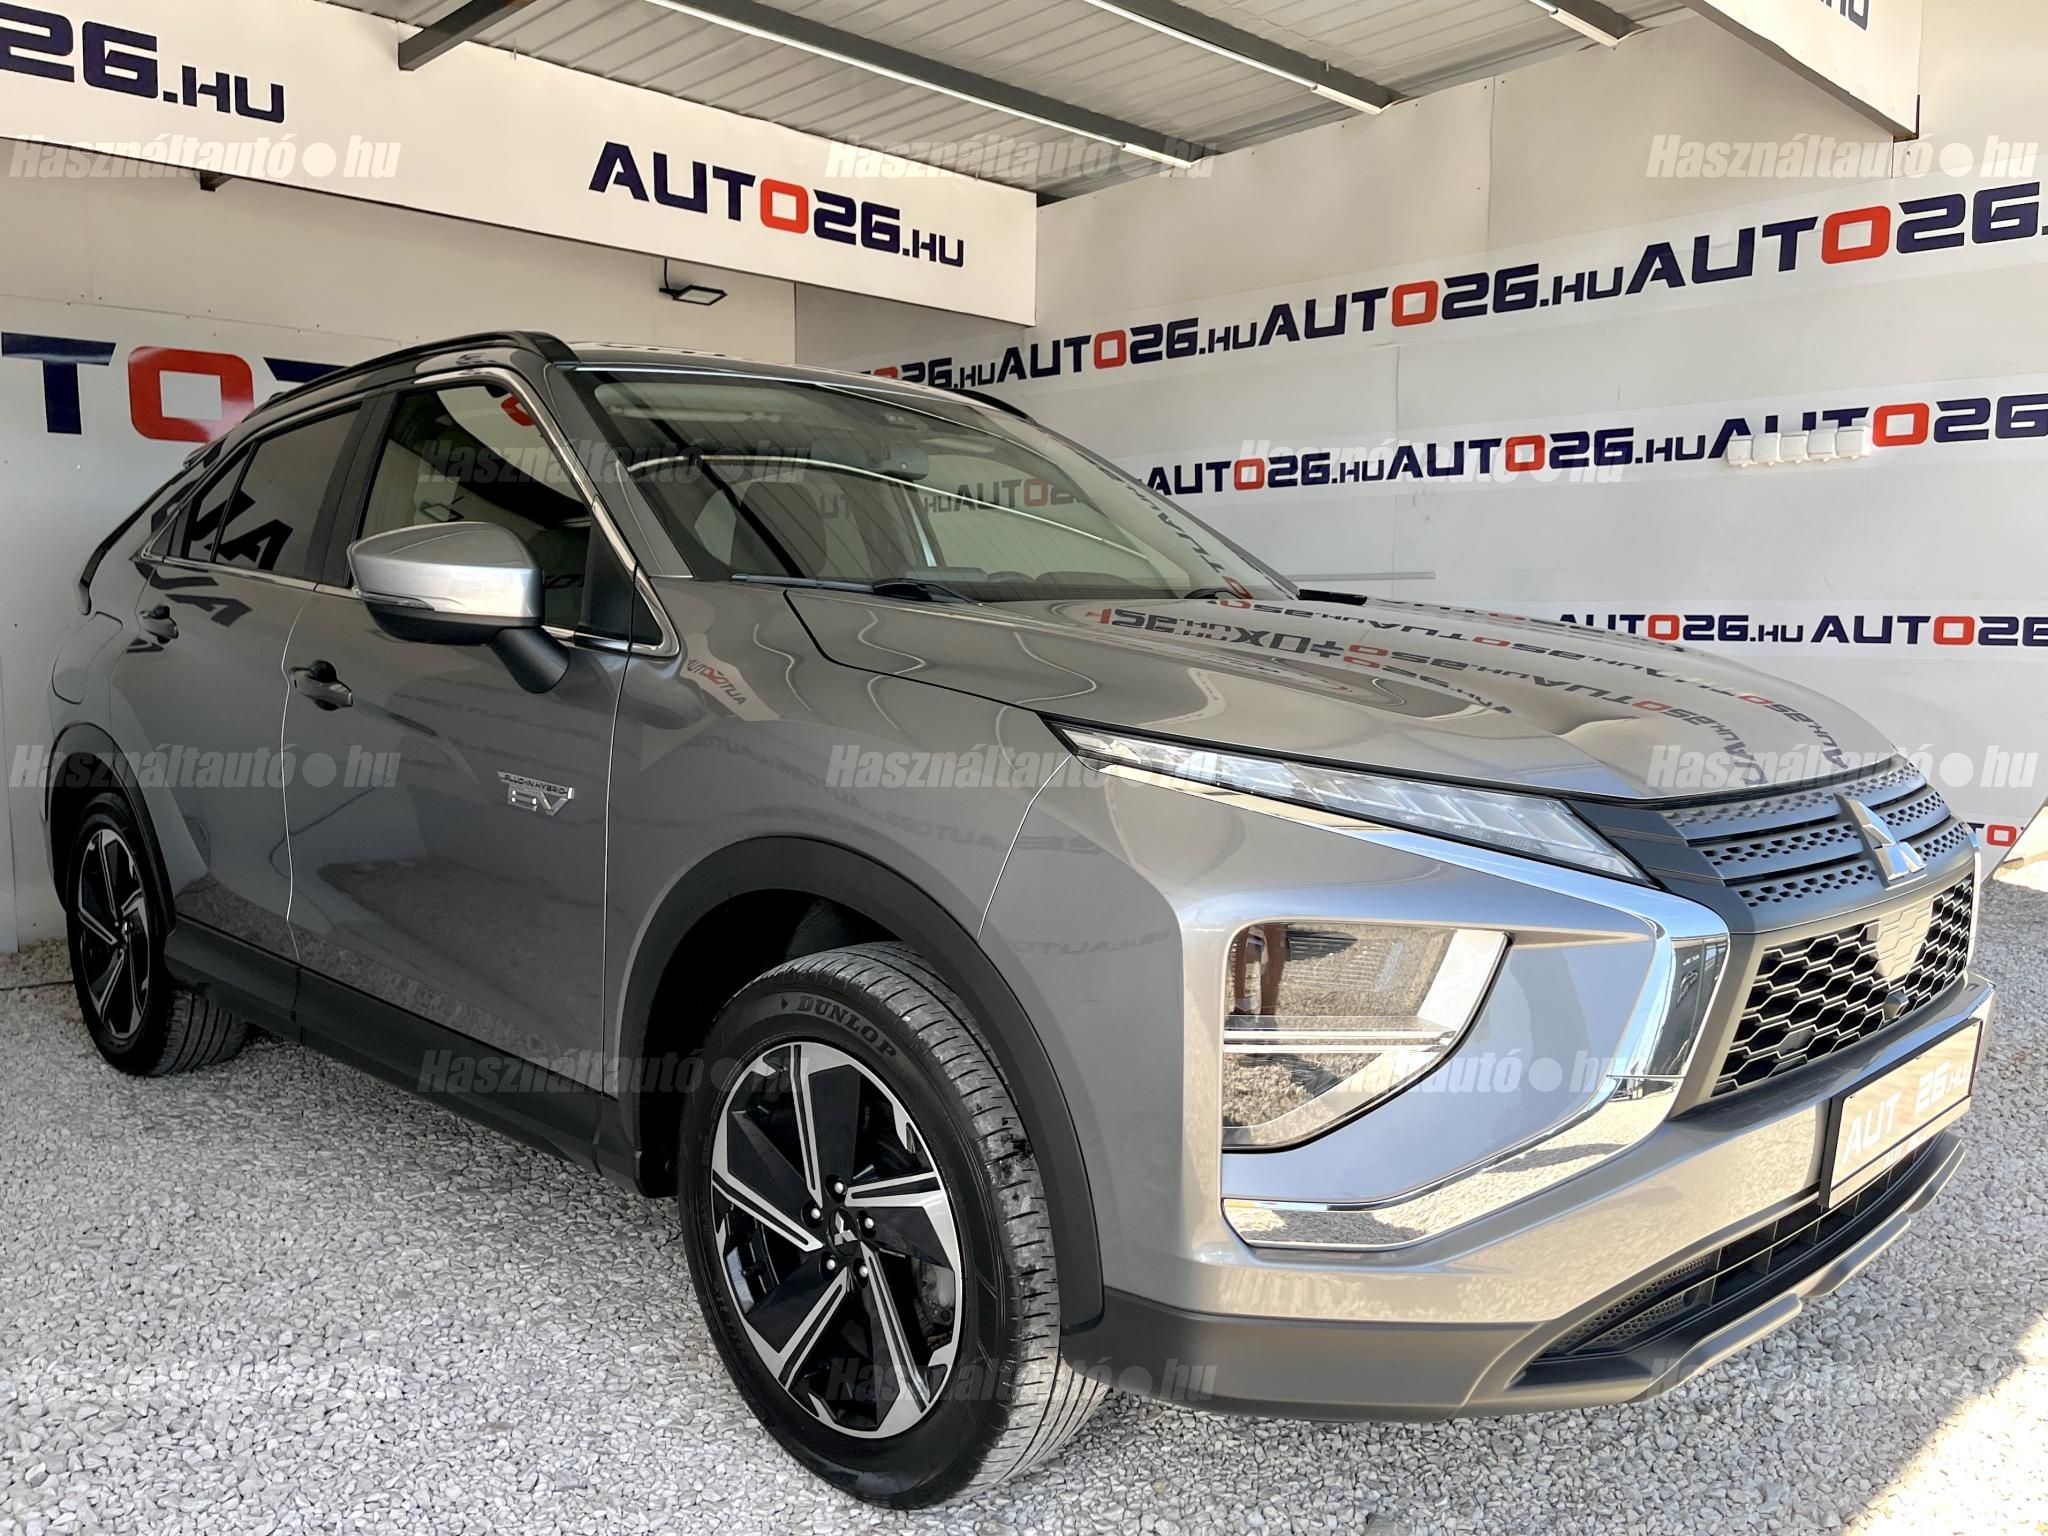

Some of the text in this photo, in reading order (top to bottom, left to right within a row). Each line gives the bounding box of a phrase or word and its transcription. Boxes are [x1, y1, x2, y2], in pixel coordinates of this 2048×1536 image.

[588, 141, 964, 268] AUTO26.HU
[997, 317, 1258, 384] AUTO26.HU
[1259, 263, 1623, 342] AUTO26.HU
[1146, 453, 1384, 496] AUTO26.HU
[1386, 427, 1706, 480] AUTO26.HU
[1559, 614, 1804, 643] TO26.HU
[535, 782, 568, 796] HYBRD
[797, 995, 897, 1056] DUNLOP
